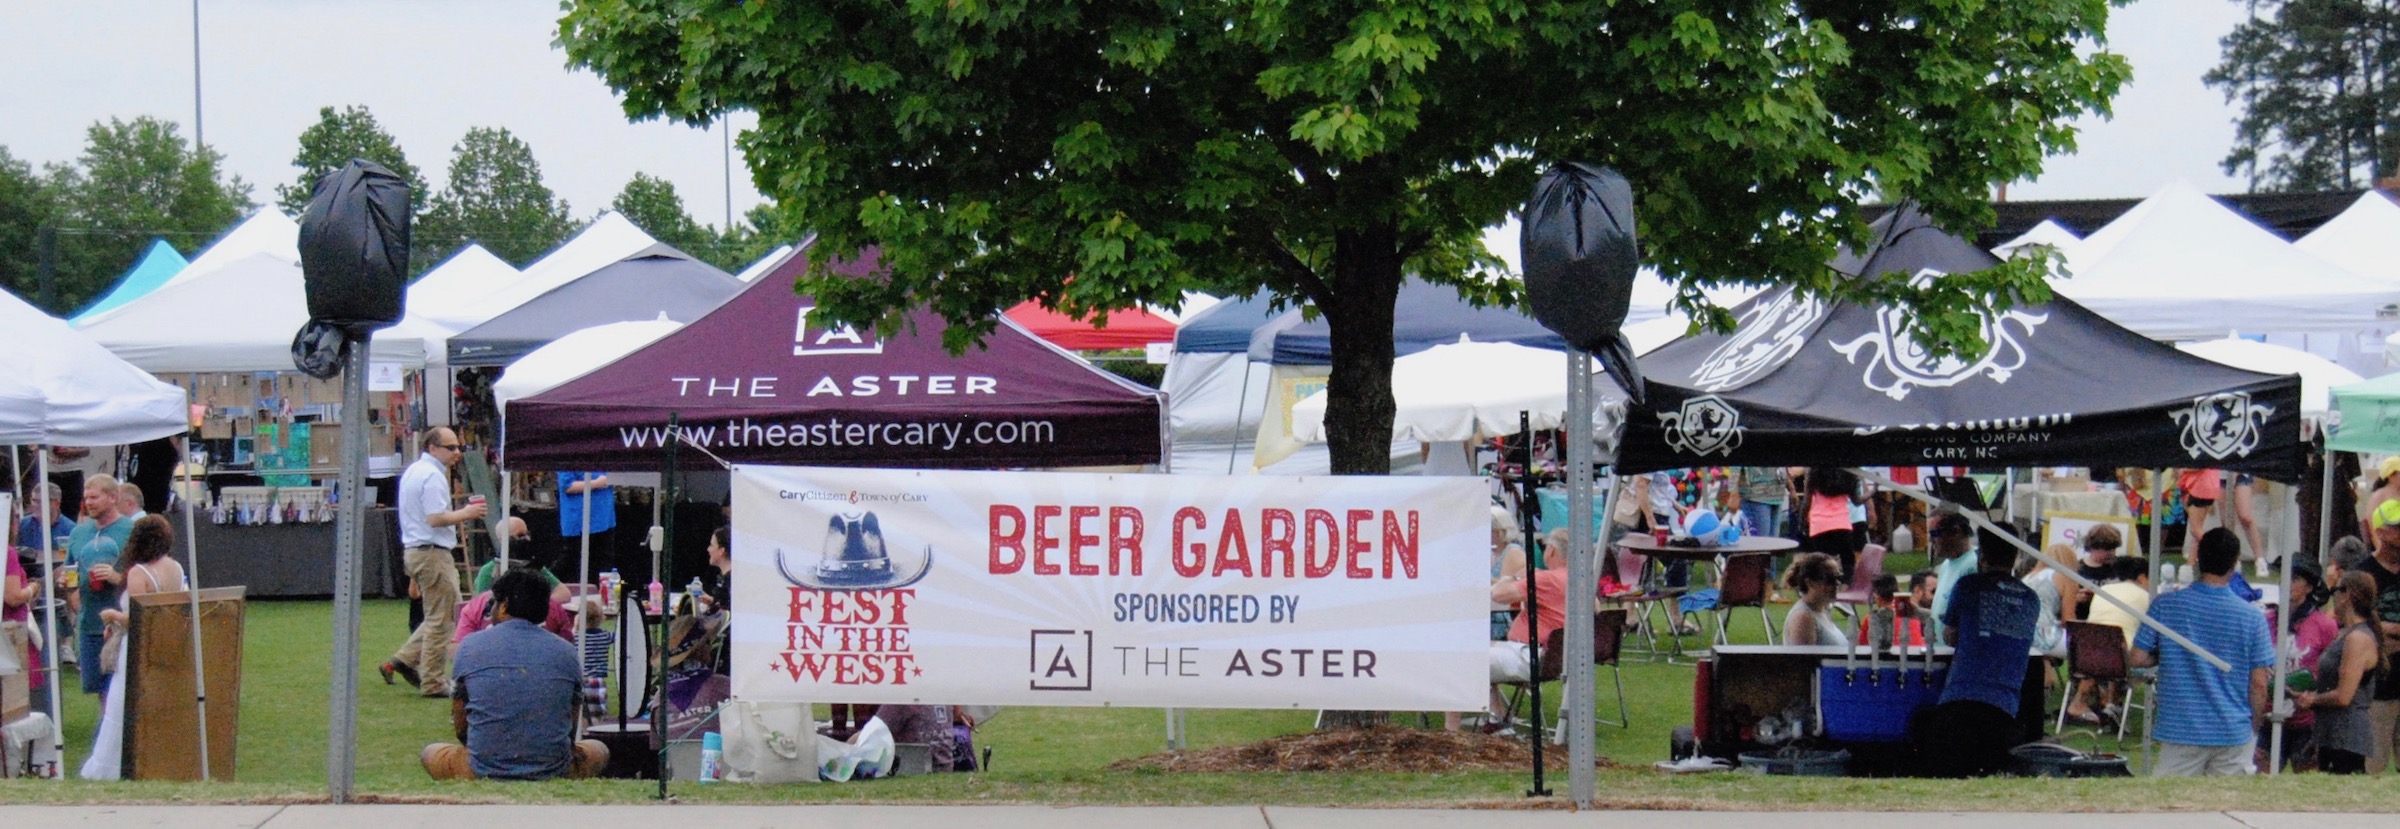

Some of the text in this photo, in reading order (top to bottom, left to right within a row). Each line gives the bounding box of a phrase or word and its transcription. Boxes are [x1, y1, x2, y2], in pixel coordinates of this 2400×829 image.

[672, 375, 998, 398] THE ASTER
[618, 416, 1055, 452] www.theastercary.com
[1969, 432, 2052, 444] COMPANY
[1922, 445, 1999, 460] CARY, NC
[779, 489, 847, 502] CaryCitizen
[860, 492, 889, 502] TOWN
[902, 492, 929, 503] CARY
[988, 504, 1419, 580] BEER GARDEN
[785, 586, 916, 626] FEST
[1112, 592, 1301, 625] SPONSORED BY
[786, 624, 911, 653] IN THE
[779, 651, 915, 686] WEST
[1112, 646, 1378, 679] THE ASTER
[678, 705, 713, 720] ASTER
